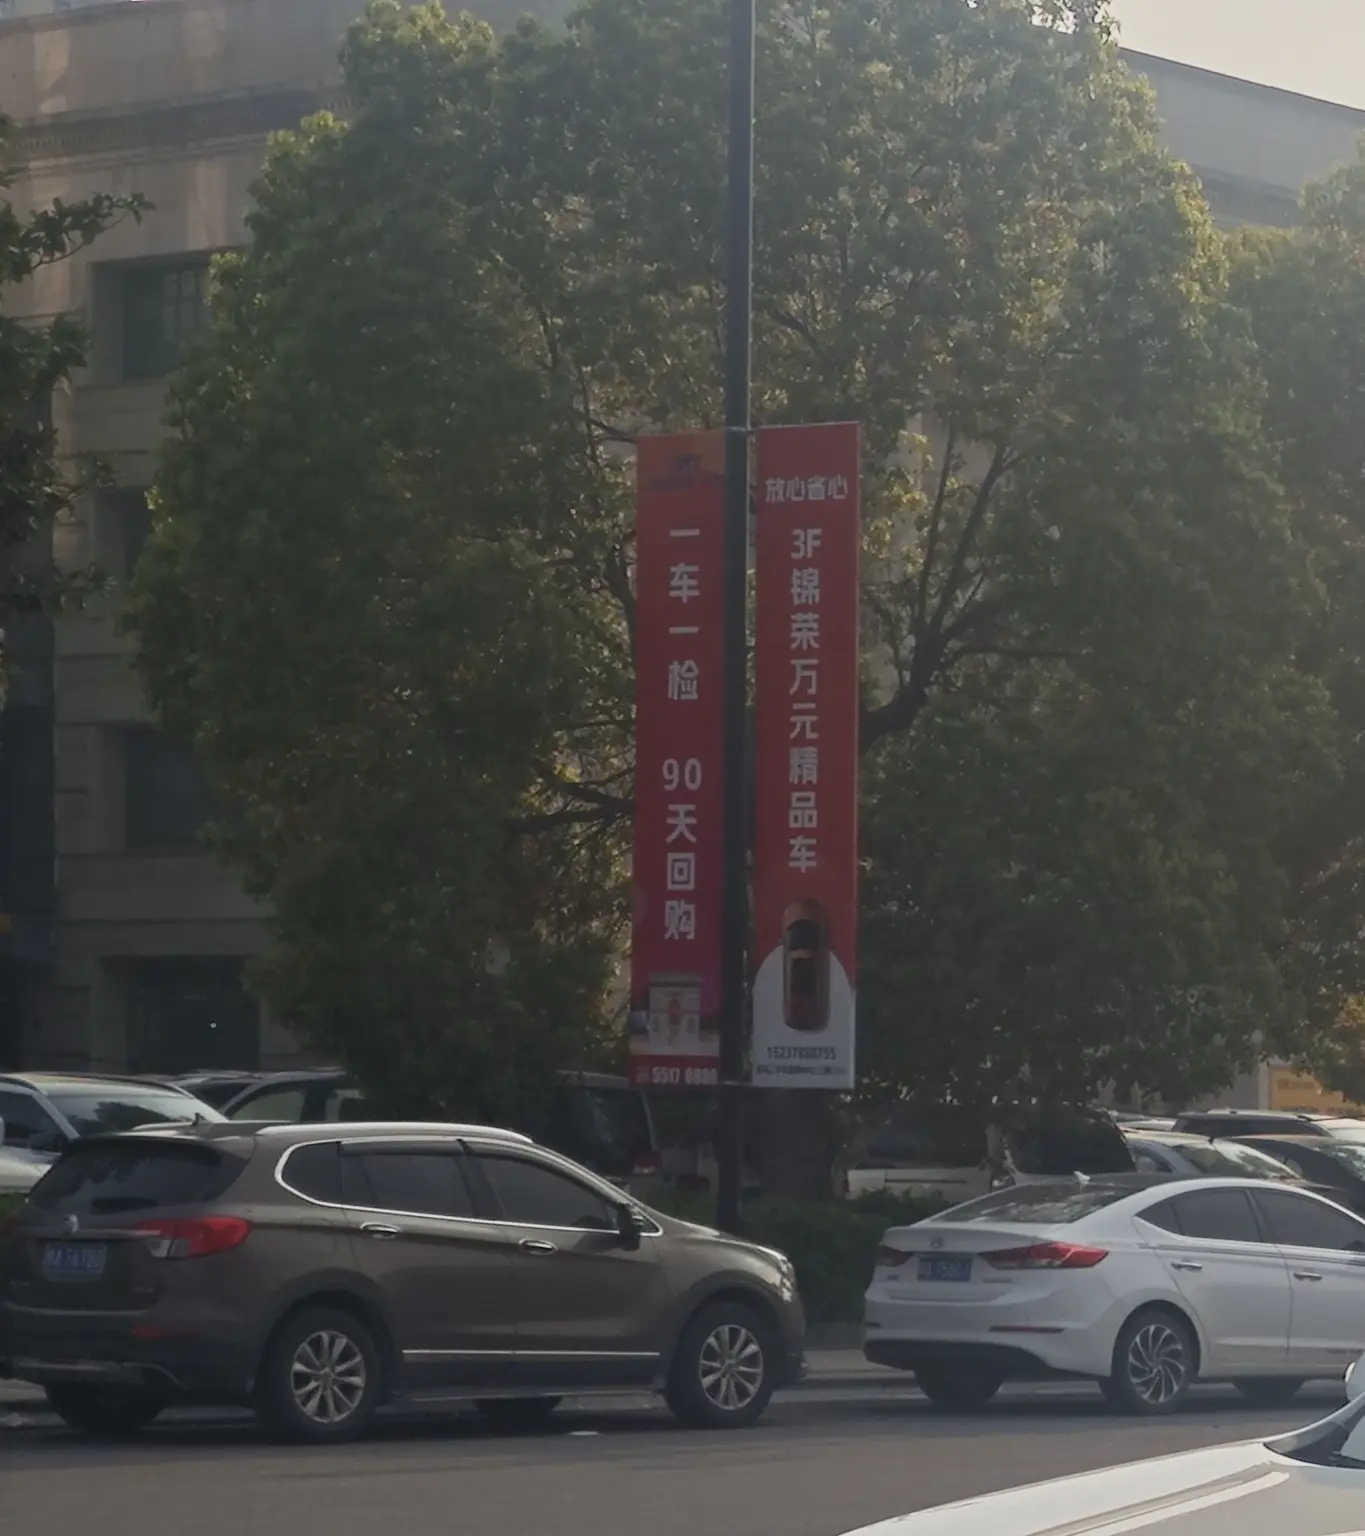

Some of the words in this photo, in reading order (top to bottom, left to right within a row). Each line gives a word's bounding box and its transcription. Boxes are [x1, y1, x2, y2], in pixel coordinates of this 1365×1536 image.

[765, 474, 848, 503] 放心省心
[668, 529, 701, 700] 一车一检
[788, 528, 822, 873] 3F锦荣万元精品车
[662, 758, 702, 940] 90天回购
